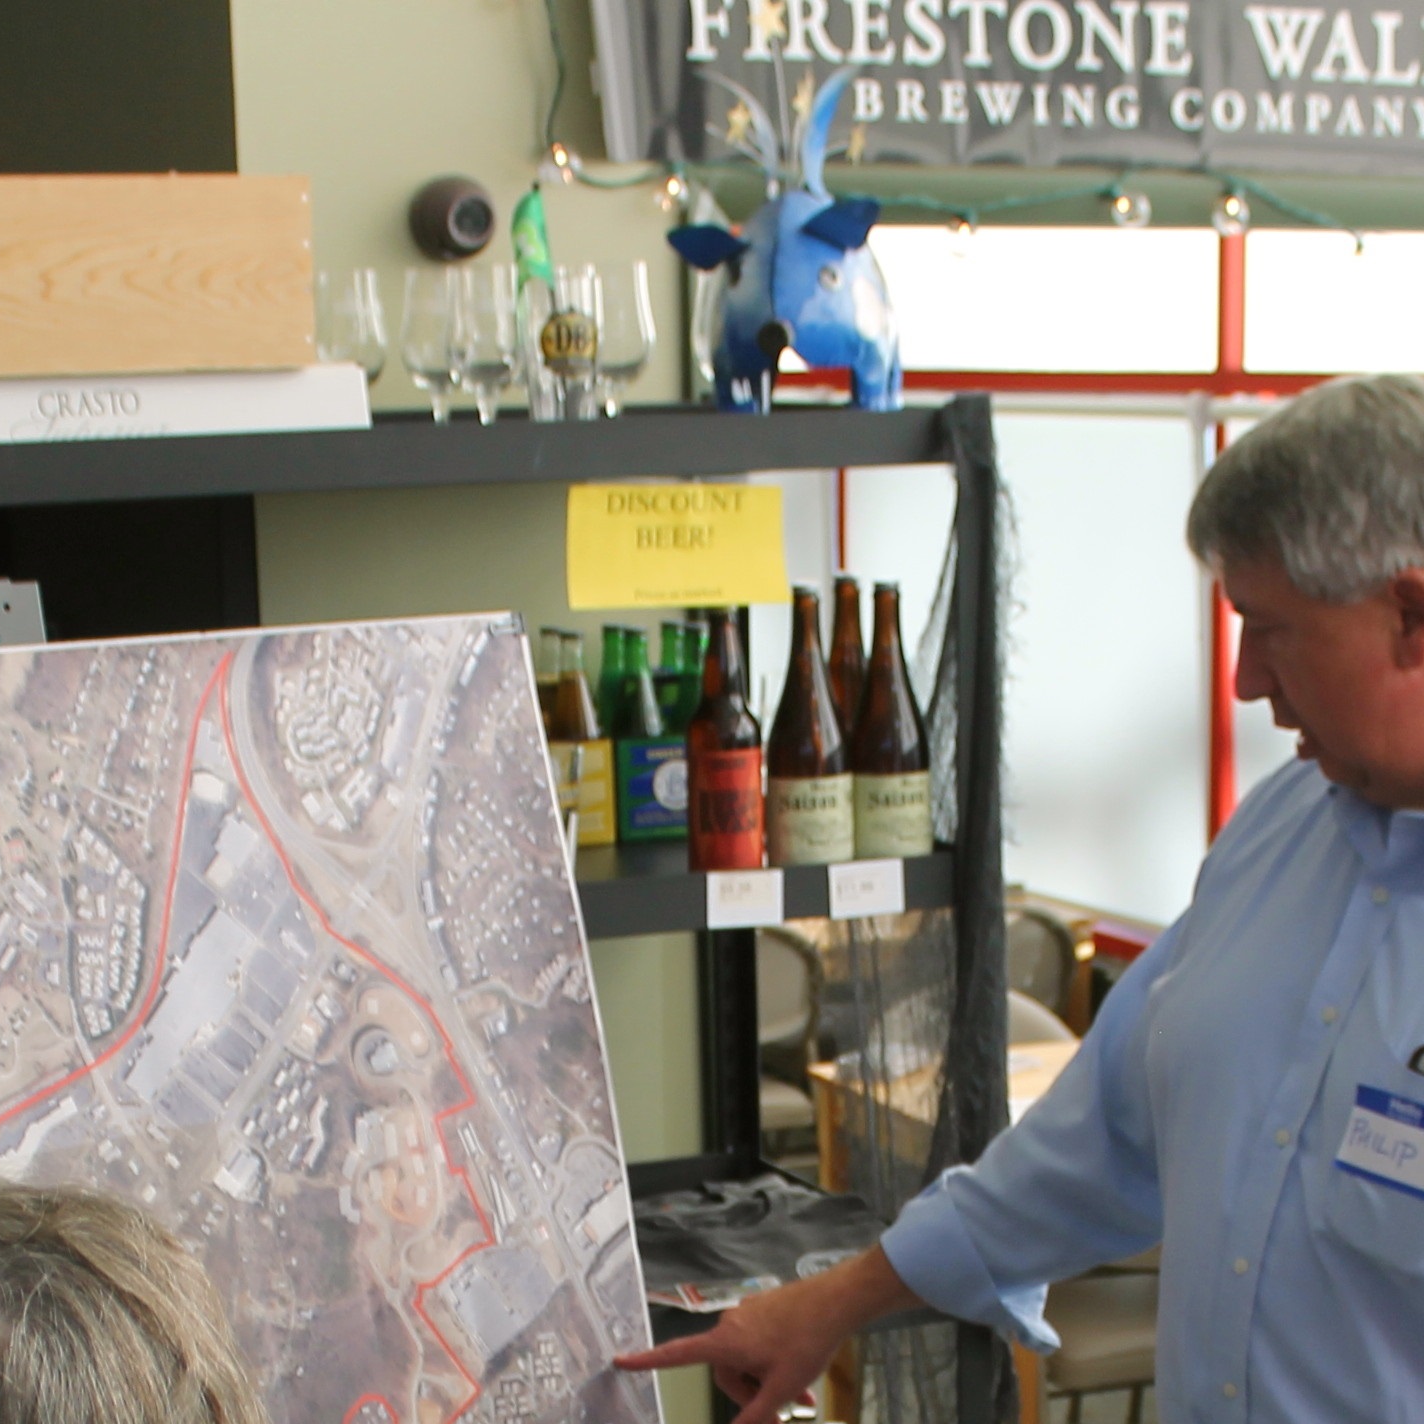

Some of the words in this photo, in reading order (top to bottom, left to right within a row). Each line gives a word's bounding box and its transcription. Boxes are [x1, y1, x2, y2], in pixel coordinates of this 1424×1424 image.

[686, 0, 1194, 75] FIRESTONE
[853, 78, 1142, 130] BREWING
[36, 387, 141, 419] CRASTO
[606, 489, 744, 515] DISCOUNT
[636, 525, 714, 550] BEER!
